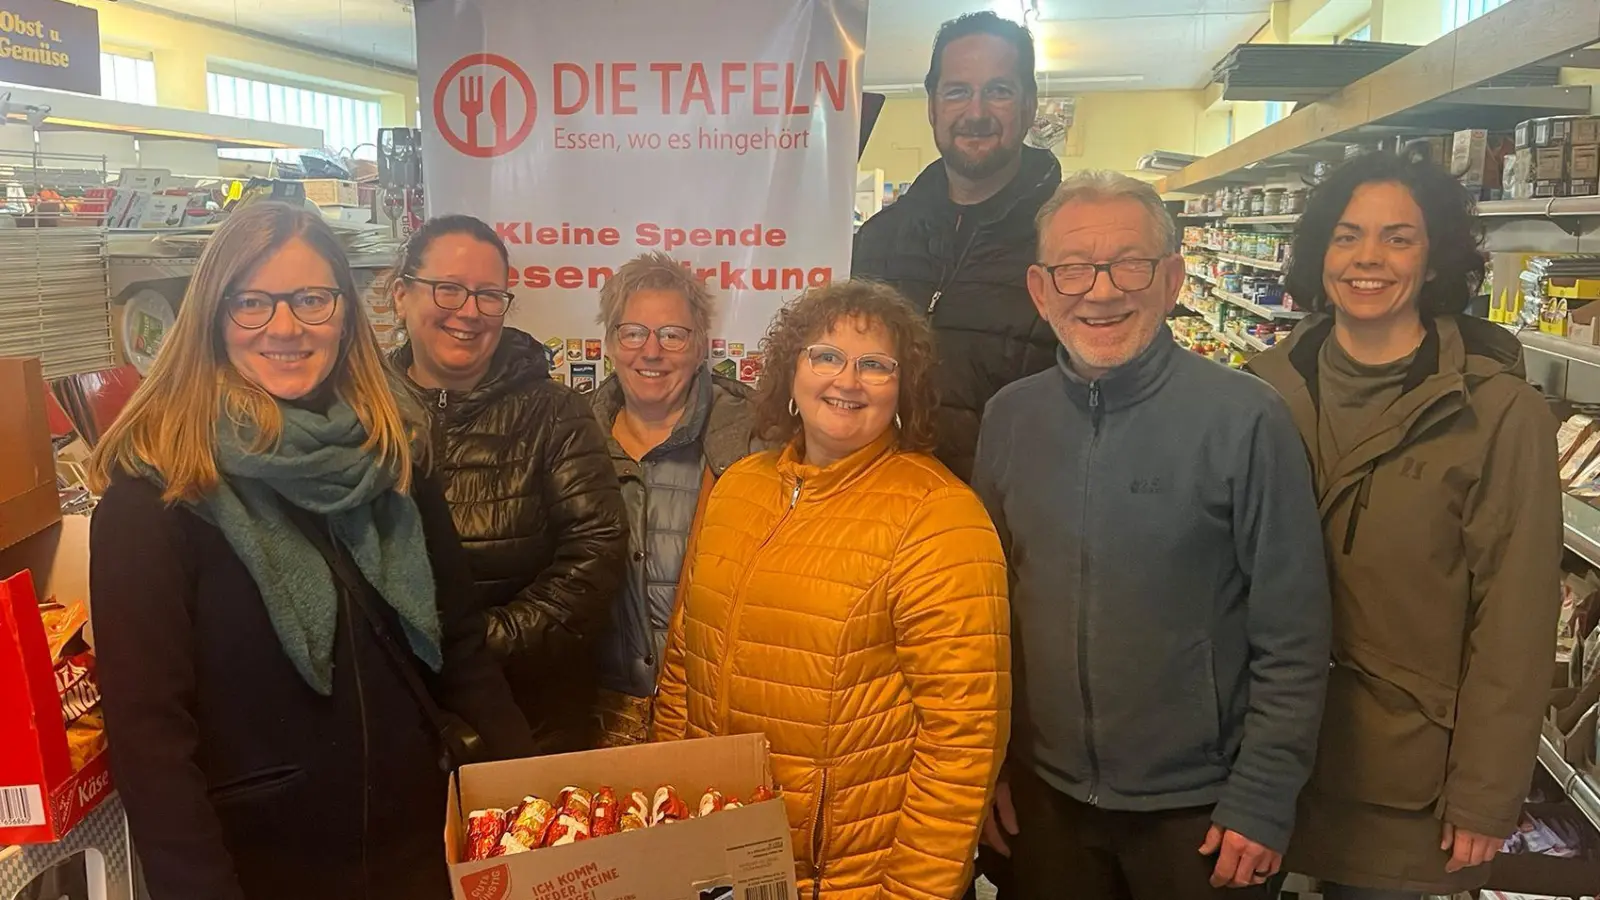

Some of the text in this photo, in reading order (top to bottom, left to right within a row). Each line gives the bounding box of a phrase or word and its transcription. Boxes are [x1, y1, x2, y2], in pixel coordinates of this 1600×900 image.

[0, 10, 62, 43] Obst u.
[0, 36, 69, 68] Gemüse
[553, 58, 848, 117] DIE TAFELN
[553, 126, 810, 155] Essen, wo es hingehört
[495, 222, 787, 252] Kleine Spende
[78, 770, 109, 808] Käse
[532, 862, 598, 897] ICH KOMM
[580, 868, 620, 890] KEINE
